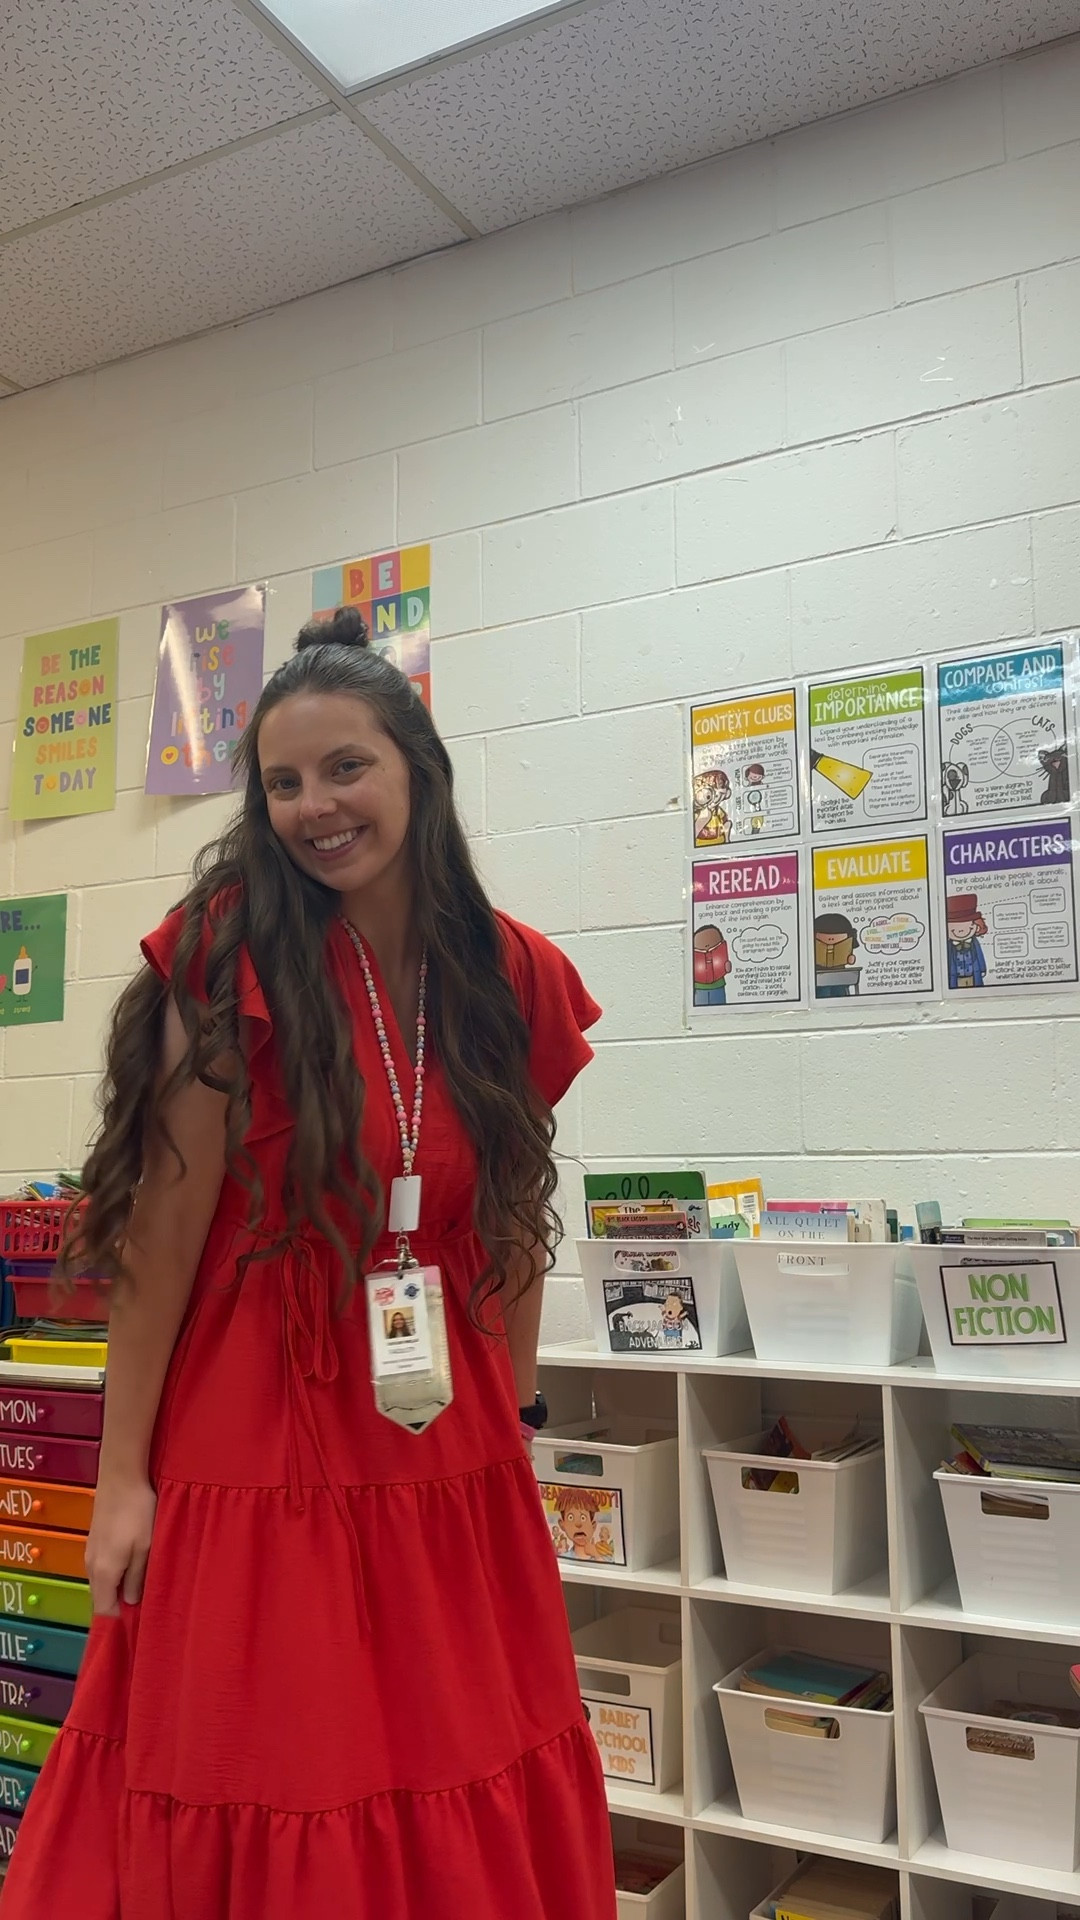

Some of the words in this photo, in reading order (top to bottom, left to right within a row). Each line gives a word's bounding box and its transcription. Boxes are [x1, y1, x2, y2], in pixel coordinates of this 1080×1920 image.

[195, 619, 230, 643] we
[41, 654, 62, 676] BE
[69, 645, 101, 670] THE
[945, 661, 1014, 688] COMPARE
[1021, 655, 1055, 677] AND
[34, 675, 105, 707] REASON
[827, 683, 888, 701] determine
[985, 674, 1044, 694] contrast
[170, 700, 248, 736] liting
[815, 687, 919, 722] IMPORTANCE
[23, 703, 111, 737] SOMEONE
[694, 710, 750, 735] CONTEXT
[754, 704, 792, 725] CLUES
[950, 723, 973, 745] DOGS
[1032, 715, 1055, 732] CATS
[36, 736, 98, 765] SMILES
[34, 767, 96, 795] TODAY
[950, 834, 1065, 865] CHARACTERS
[709, 865, 780, 895] REREAD
[827, 850, 911, 881] EVALUATE
[765, 1216, 790, 1226] ALL
[795, 1218, 841, 1228] QUIET
[801, 1231, 825, 1239] THE
[777, 1254, 826, 1266] FRONT
[967, 1273, 1030, 1303] NON
[952, 1305, 1057, 1337] FICTION
[0, 1400, 36, 1424] MON
[0, 1445, 34, 1471] TUES
[0, 1582, 24, 1614] RI
[595, 1730, 647, 1754] SCHOOL
[607, 1754, 636, 1774] KIDS
